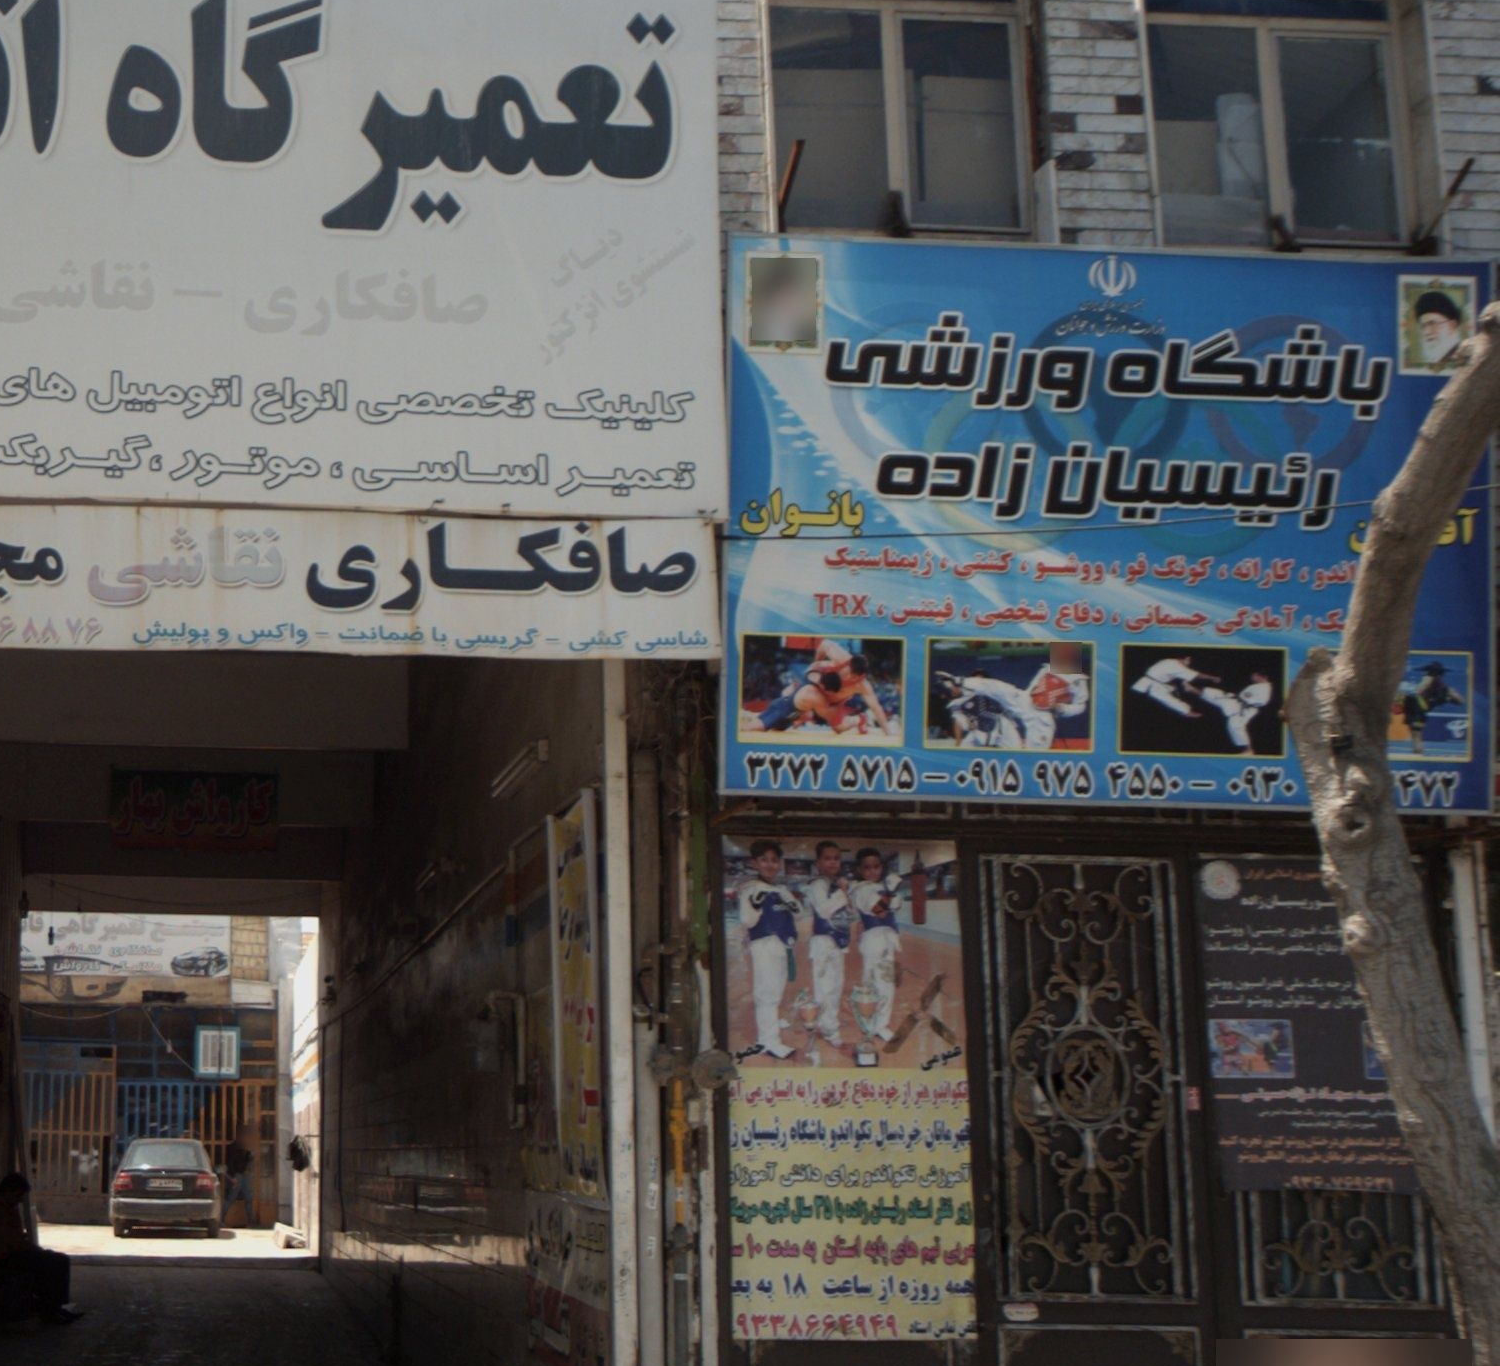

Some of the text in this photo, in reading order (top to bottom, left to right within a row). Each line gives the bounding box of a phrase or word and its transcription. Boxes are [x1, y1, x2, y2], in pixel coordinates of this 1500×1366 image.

[243, 270, 489, 335] صافکاری
[825, 312, 1391, 420] باشگاه ورزشی
[87, 370, 242, 418] اتومبیل
[252, 377, 348, 423] انواع
[356, 387, 536, 424] تخصصی
[546, 389, 695, 430] کلینیک
[171, 447, 320, 490] موتور
[352, 450, 548, 491] اساسی
[555, 461, 696, 497] تعمیر
[875, 444, 1033, 519] زاده
[740, 490, 864, 537] بانوان
[88, 524, 286, 606] نقاشی
[307, 518, 697, 612] صافکاری
[824, 547, 933, 577] ژیمناستیک
[954, 551, 1015, 579] کشتی
[1124, 555, 1147, 580] فو
[1152, 555, 1212, 582] کونگ
[1232, 558, 1295, 586] کاراته
[814, 595, 869, 619] TRX
[891, 596, 955, 627] فیتنس
[974, 599, 1047, 630] شخصی
[1054, 601, 1105, 630] دفاع
[1125, 602, 1207, 633] جسمانی
[1215, 605, 1298, 635] آمادگی
[132, 622, 211, 647] پولیش
[216, 626, 230, 644] و
[237, 621, 309, 645] واکس
[337, 624, 427, 645] ضمانت
[430, 626, 448, 647] با
[567, 627, 629, 654] کشی
[634, 626, 708, 653] شاسی
[839, 754, 917, 793] ۵۷۱۵
[955, 759, 1022, 796] ۰۹۱۵
[1034, 760, 1097, 797] ۹۷۵
[1106, 762, 1186, 800] ۴۵۵۰
[781, 1163, 972, 1188] آموزش تکواندو برای دانش
[755, 1279, 774, 1302] به
[782, 1273, 807, 1295] ۱۸
[823, 1274, 873, 1299] ساعت
[877, 1275, 894, 1304] از
[899, 1278, 941, 1304] روزه
